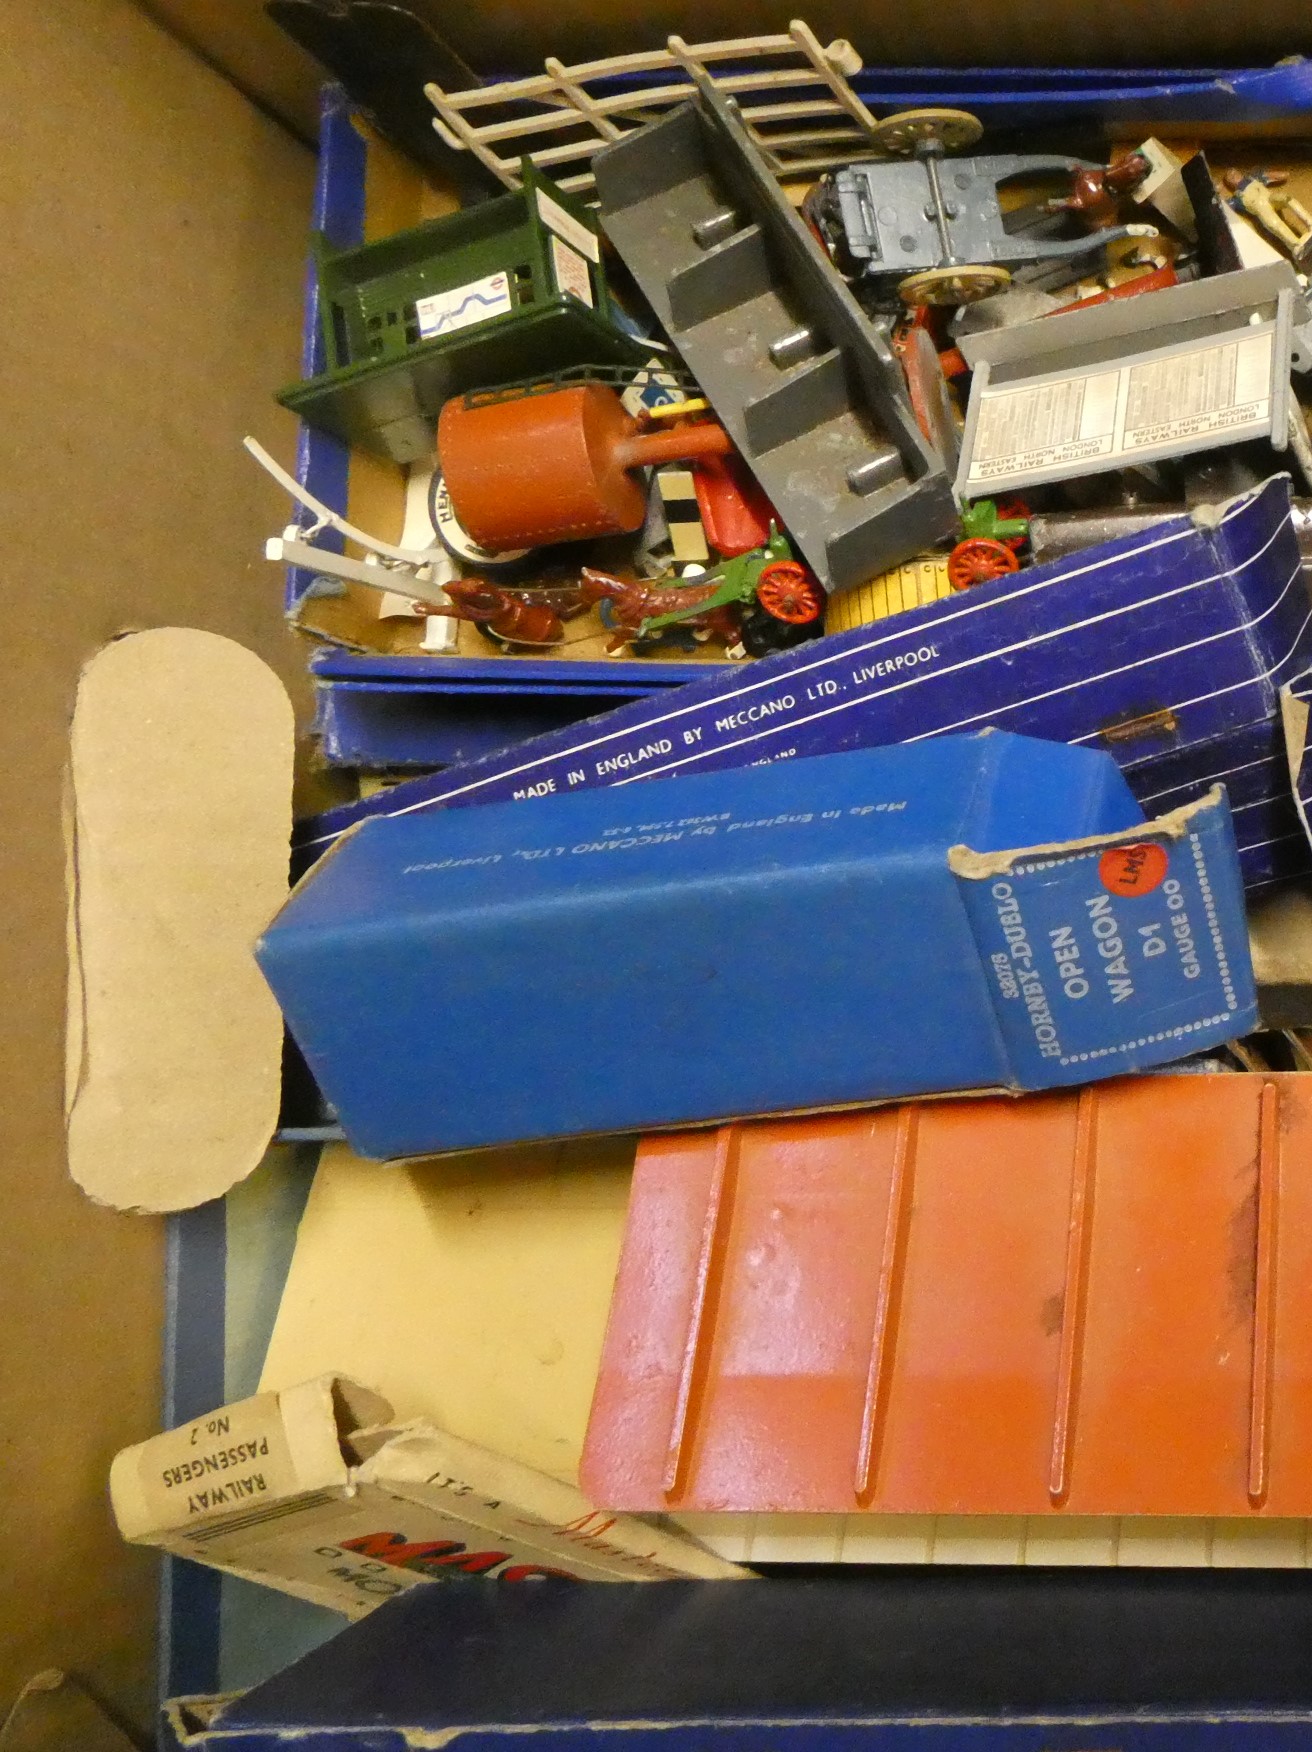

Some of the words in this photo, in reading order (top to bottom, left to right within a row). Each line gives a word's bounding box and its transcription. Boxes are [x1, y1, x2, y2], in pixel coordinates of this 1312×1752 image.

[1208, 411, 1257, 429] BRITISH
[1218, 403, 1260, 418] LONDON
[1062, 439, 1103, 453] LONDON
[1135, 425, 1199, 445] RAILWAYS
[980, 458, 1044, 476] RAILWAYS
[1053, 446, 1100, 462] BRITISH
[514, 779, 556, 801] MADE
[568, 769, 585, 786] IN
[596, 739, 672, 776] ENGLAND
[683, 727, 702, 745] BY
[716, 695, 796, 733] MECCANO
[852, 646, 940, 684] LIVERPOOL
[727, 813, 814, 832] England
[849, 801, 907, 816] Made
[572, 830, 684, 855] MECCANO
[1119, 850, 1147, 885] LMS
[1086, 895, 1134, 1004] WAGON
[1138, 923, 1166, 958] D1
[1170, 912, 1200, 979] GAUGE
[992, 882, 1061, 1058] HORNBY-DUBLO
[1049, 926, 1089, 998] OPEN
[162, 1437, 269, 1488] PASSENGERS
[188, 1472, 267, 1514] RAILWAY
